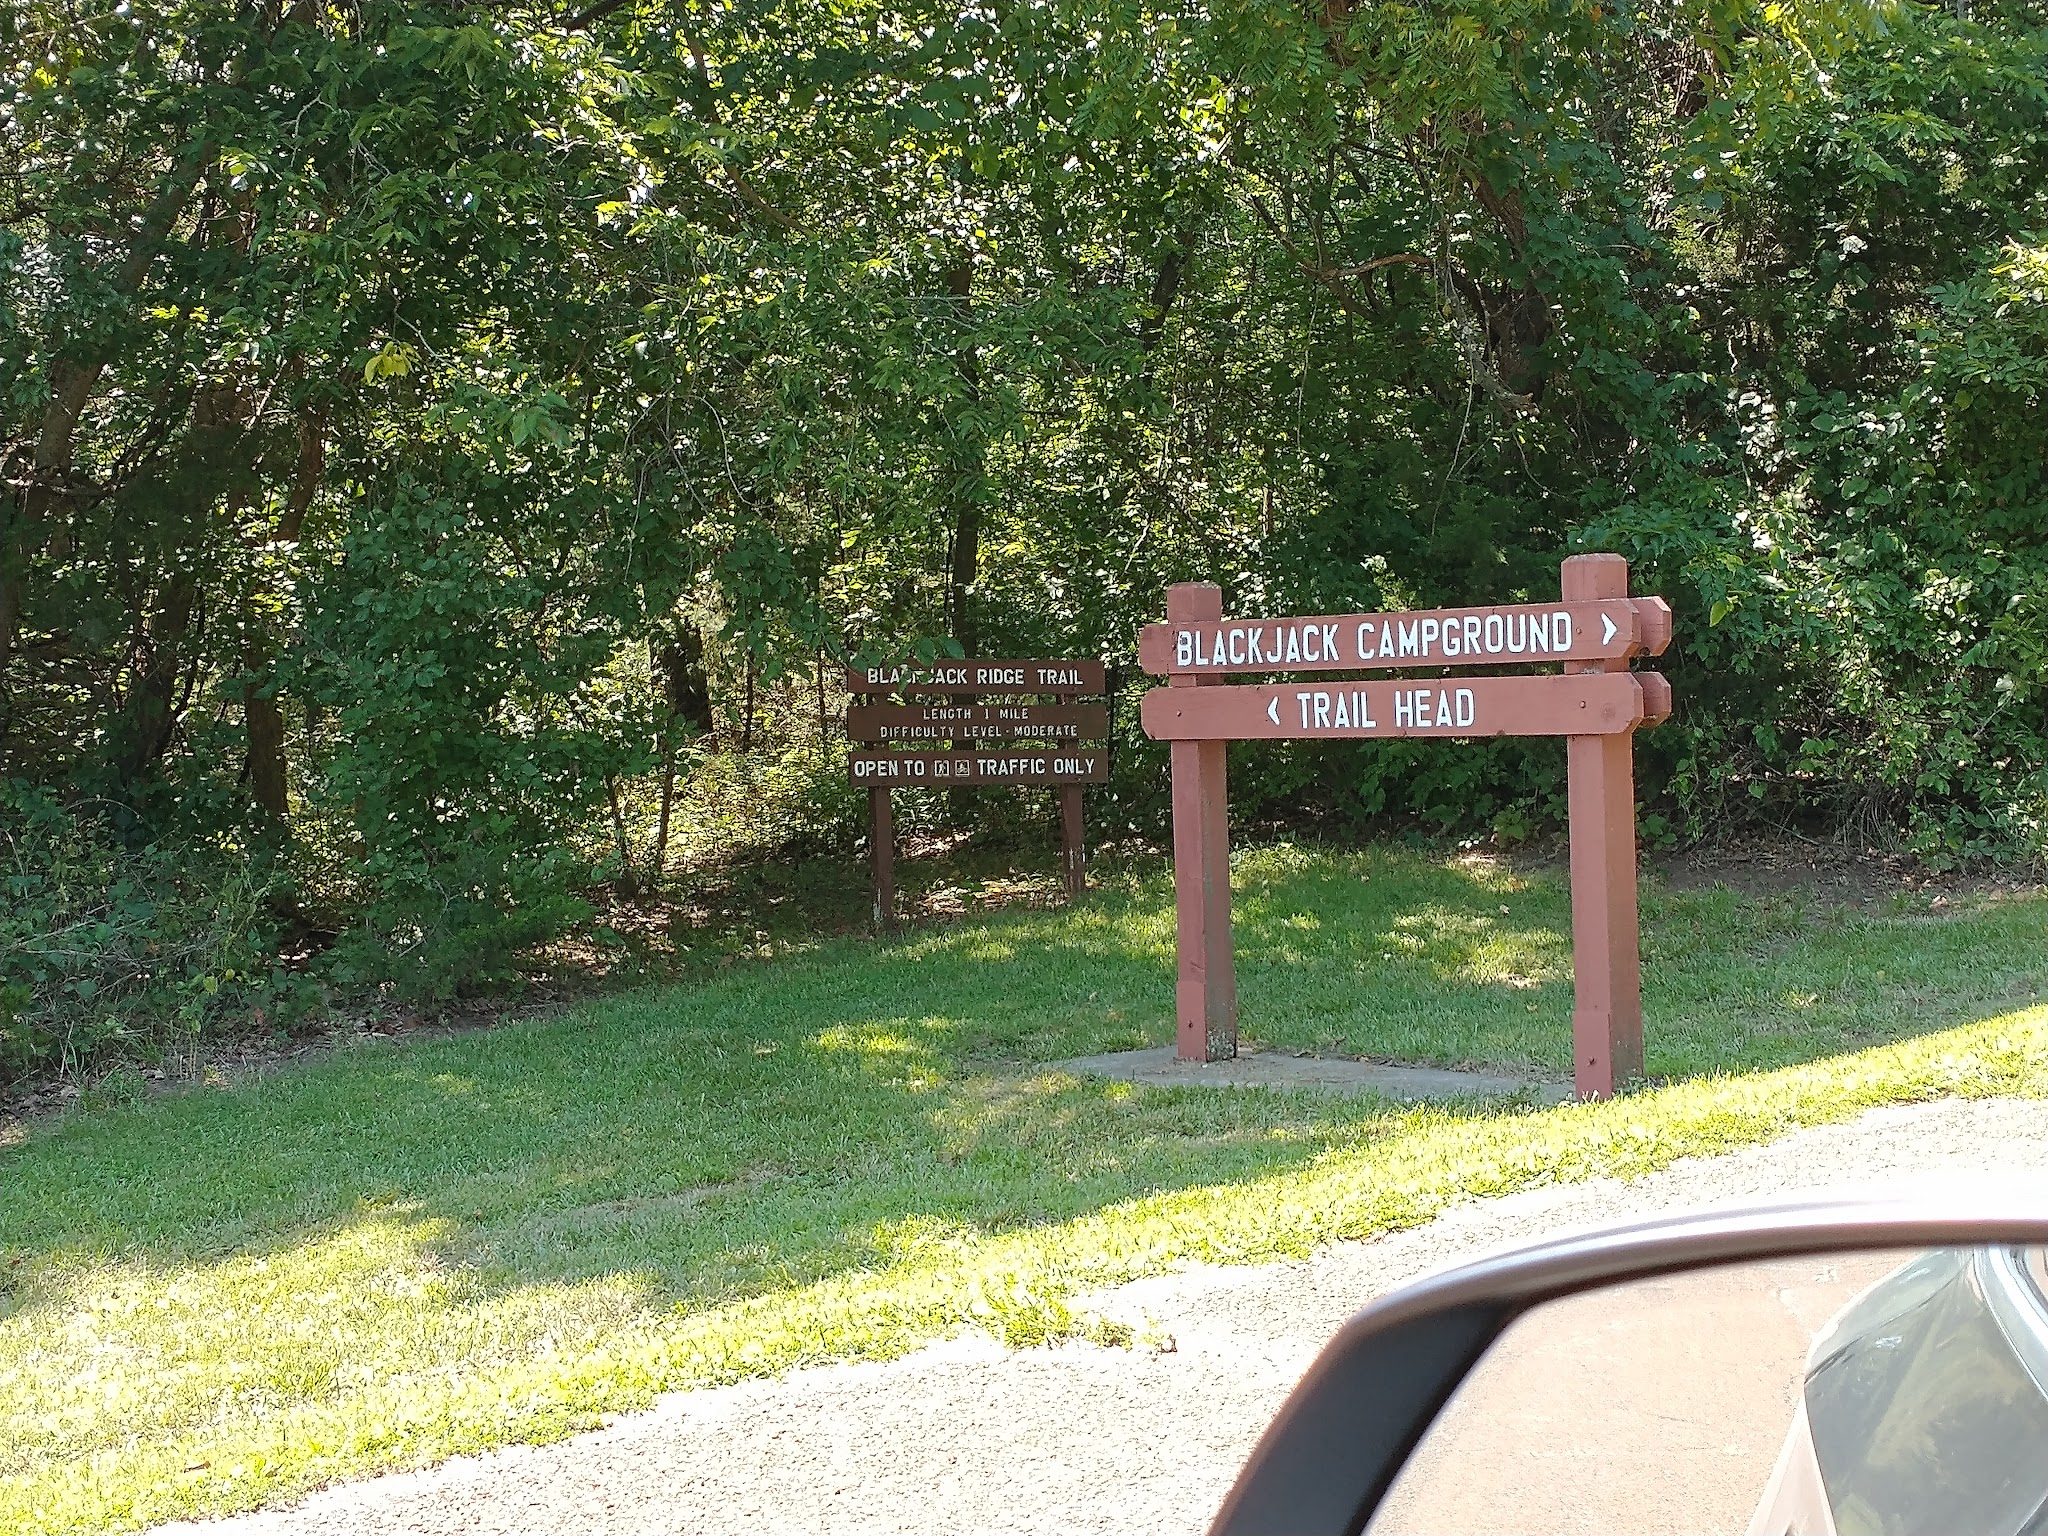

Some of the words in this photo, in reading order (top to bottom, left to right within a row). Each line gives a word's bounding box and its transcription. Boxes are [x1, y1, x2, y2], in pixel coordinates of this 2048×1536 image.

[1176, 623, 1341, 668] BLACKJACK
[1356, 611, 1573, 661] CAMPGROUND
[977, 668, 1025, 684] RIDGE
[1037, 669, 1083, 685] TRAIL
[923, 708, 972, 720] LENGTH
[984, 708, 989, 719] 1
[999, 708, 1029, 719] MILE
[1296, 691, 1377, 730] TRAIL
[1394, 688, 1476, 728] HEAD
[880, 726, 954, 738] DIFFICULTY
[854, 760, 898, 777] OPEN
[904, 760, 925, 776] TO
[977, 758, 1045, 775] TRAFFIC
[1054, 758, 1095, 774] ONLY
